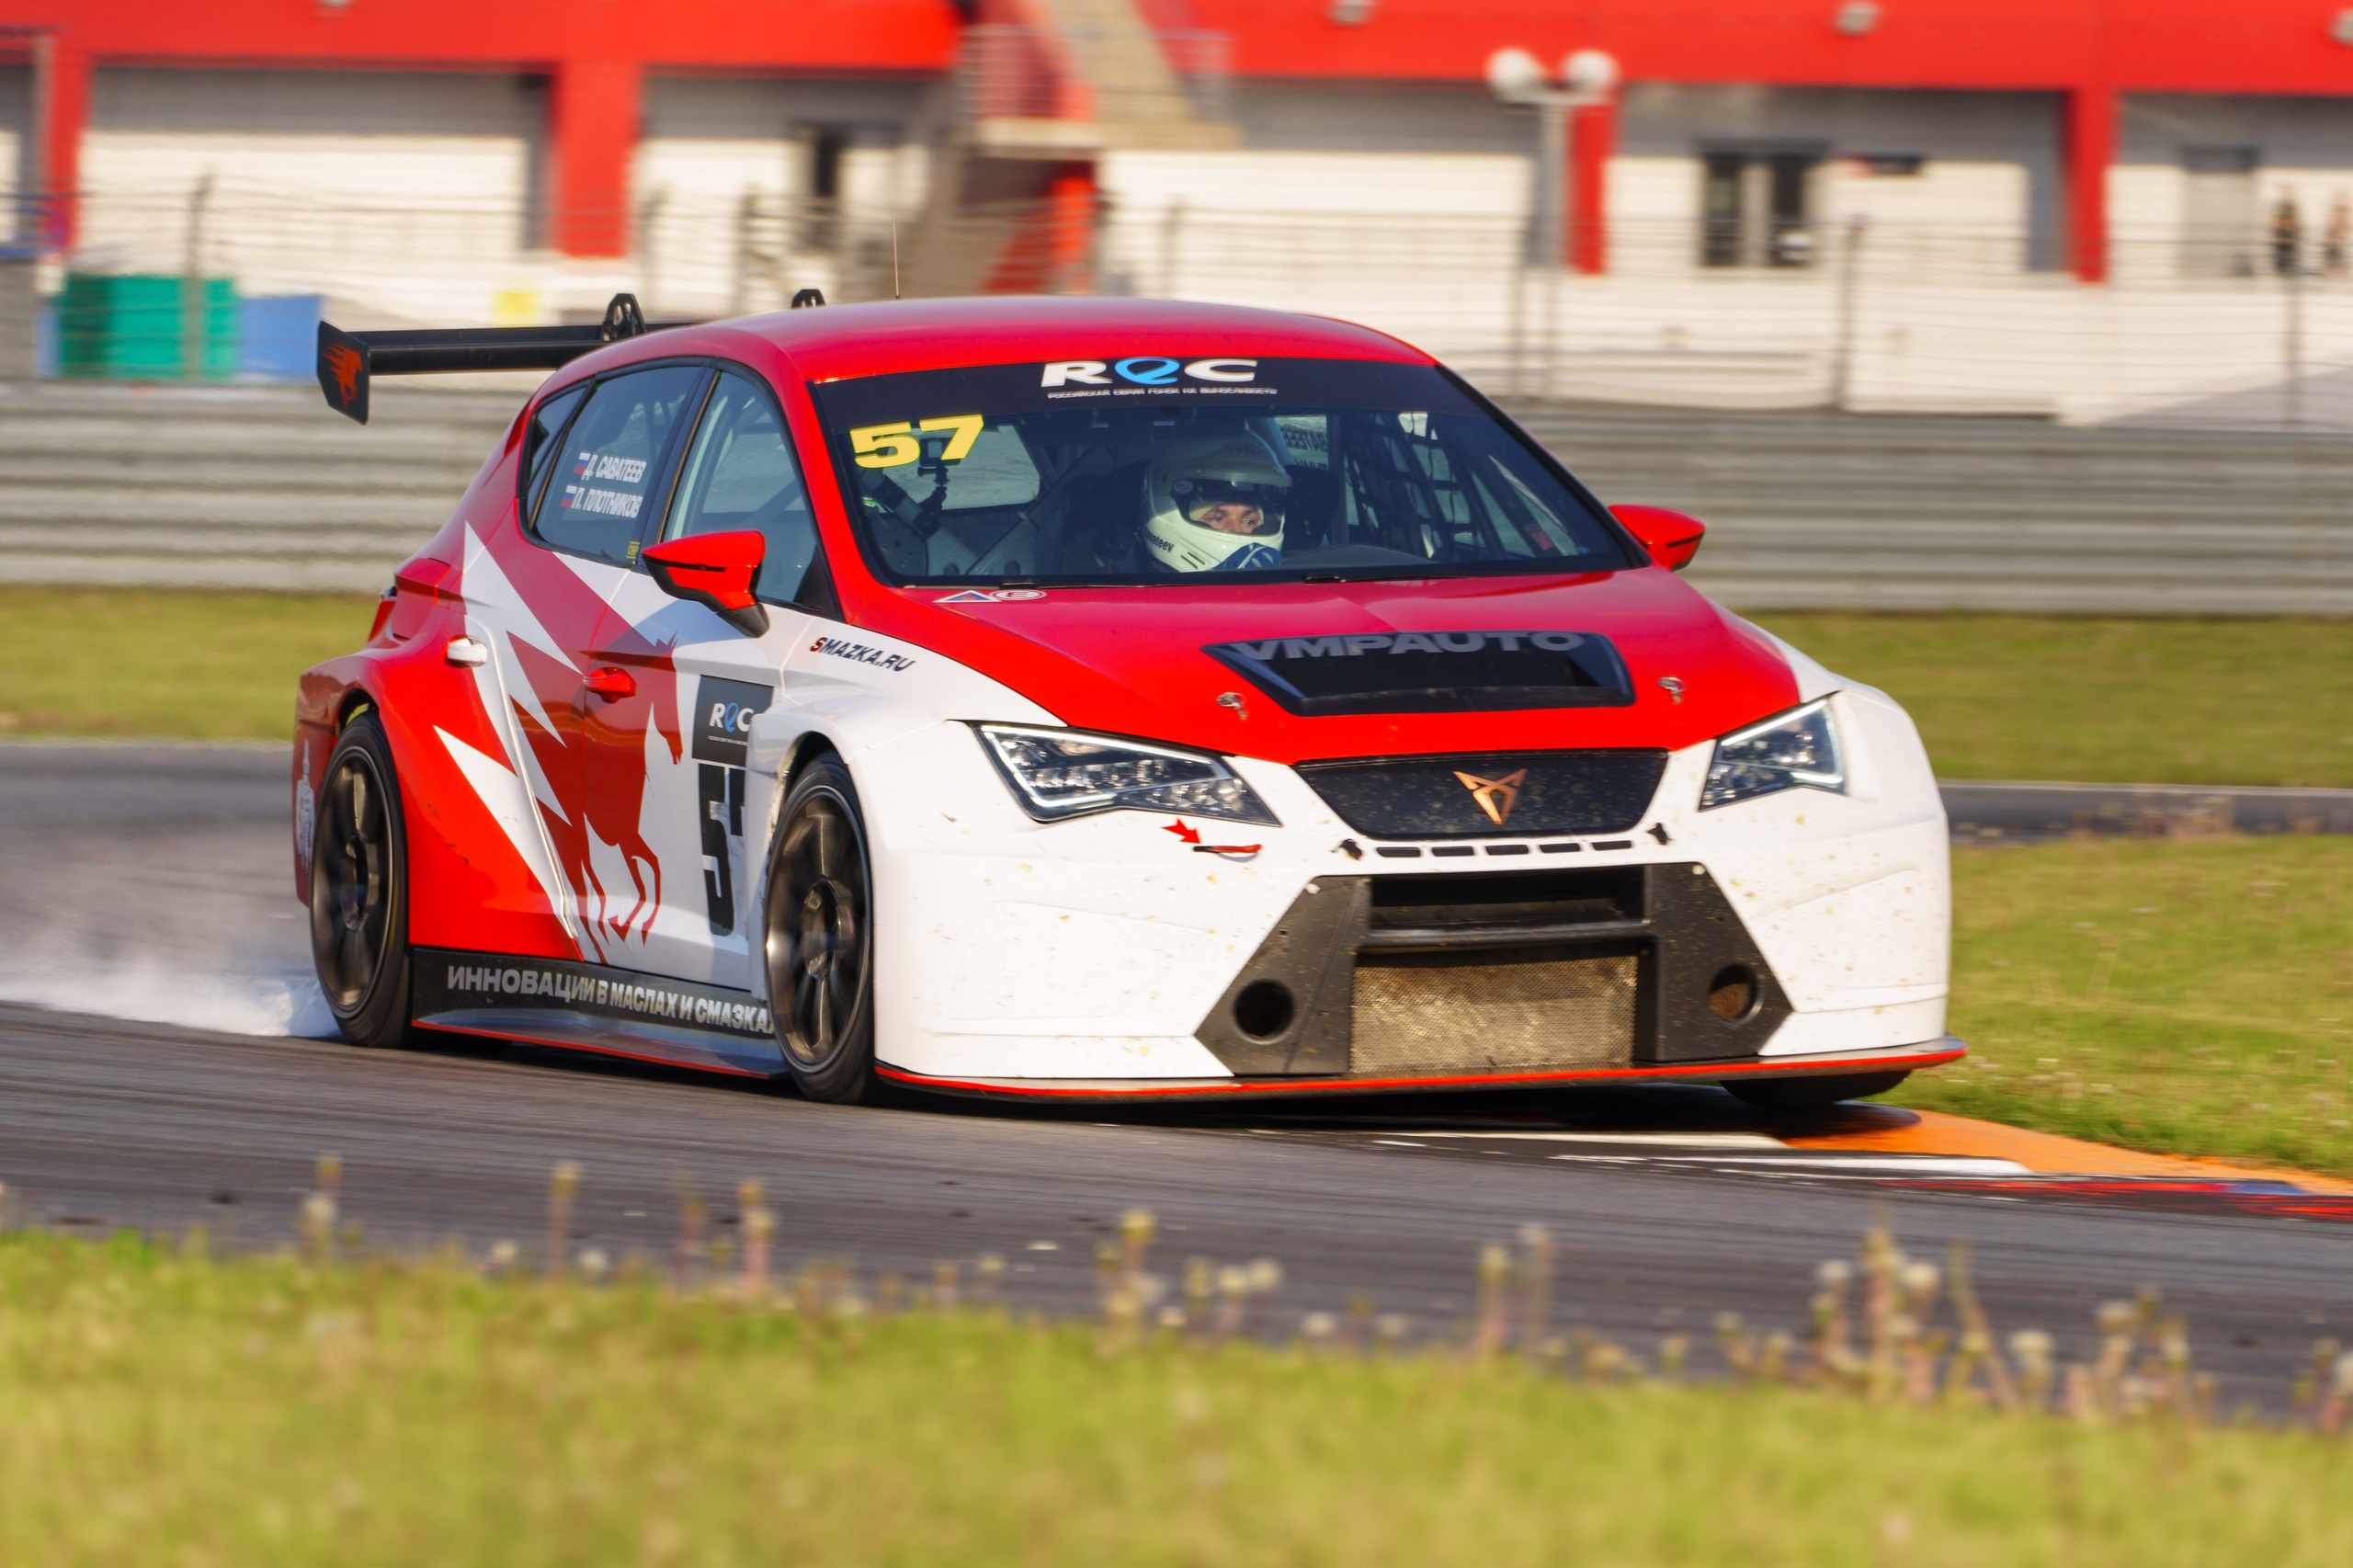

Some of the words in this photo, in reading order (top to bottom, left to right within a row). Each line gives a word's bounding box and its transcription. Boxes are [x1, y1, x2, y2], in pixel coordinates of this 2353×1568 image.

[850, 415, 984, 469] 57
[596, 456, 647, 483] САВАТЕЕВ
[583, 489, 643, 518] ПЛОТНИКОВ
[810, 637, 916, 672] SMAZKA.RU
[1228, 631, 1587, 661] VMPAUTO
[448, 966, 596, 1003] ИННОВАЦИИ
[597, 980, 608, 1006] В
[609, 982, 679, 1018] МАСЛАХ
[678, 994, 694, 1021] И
